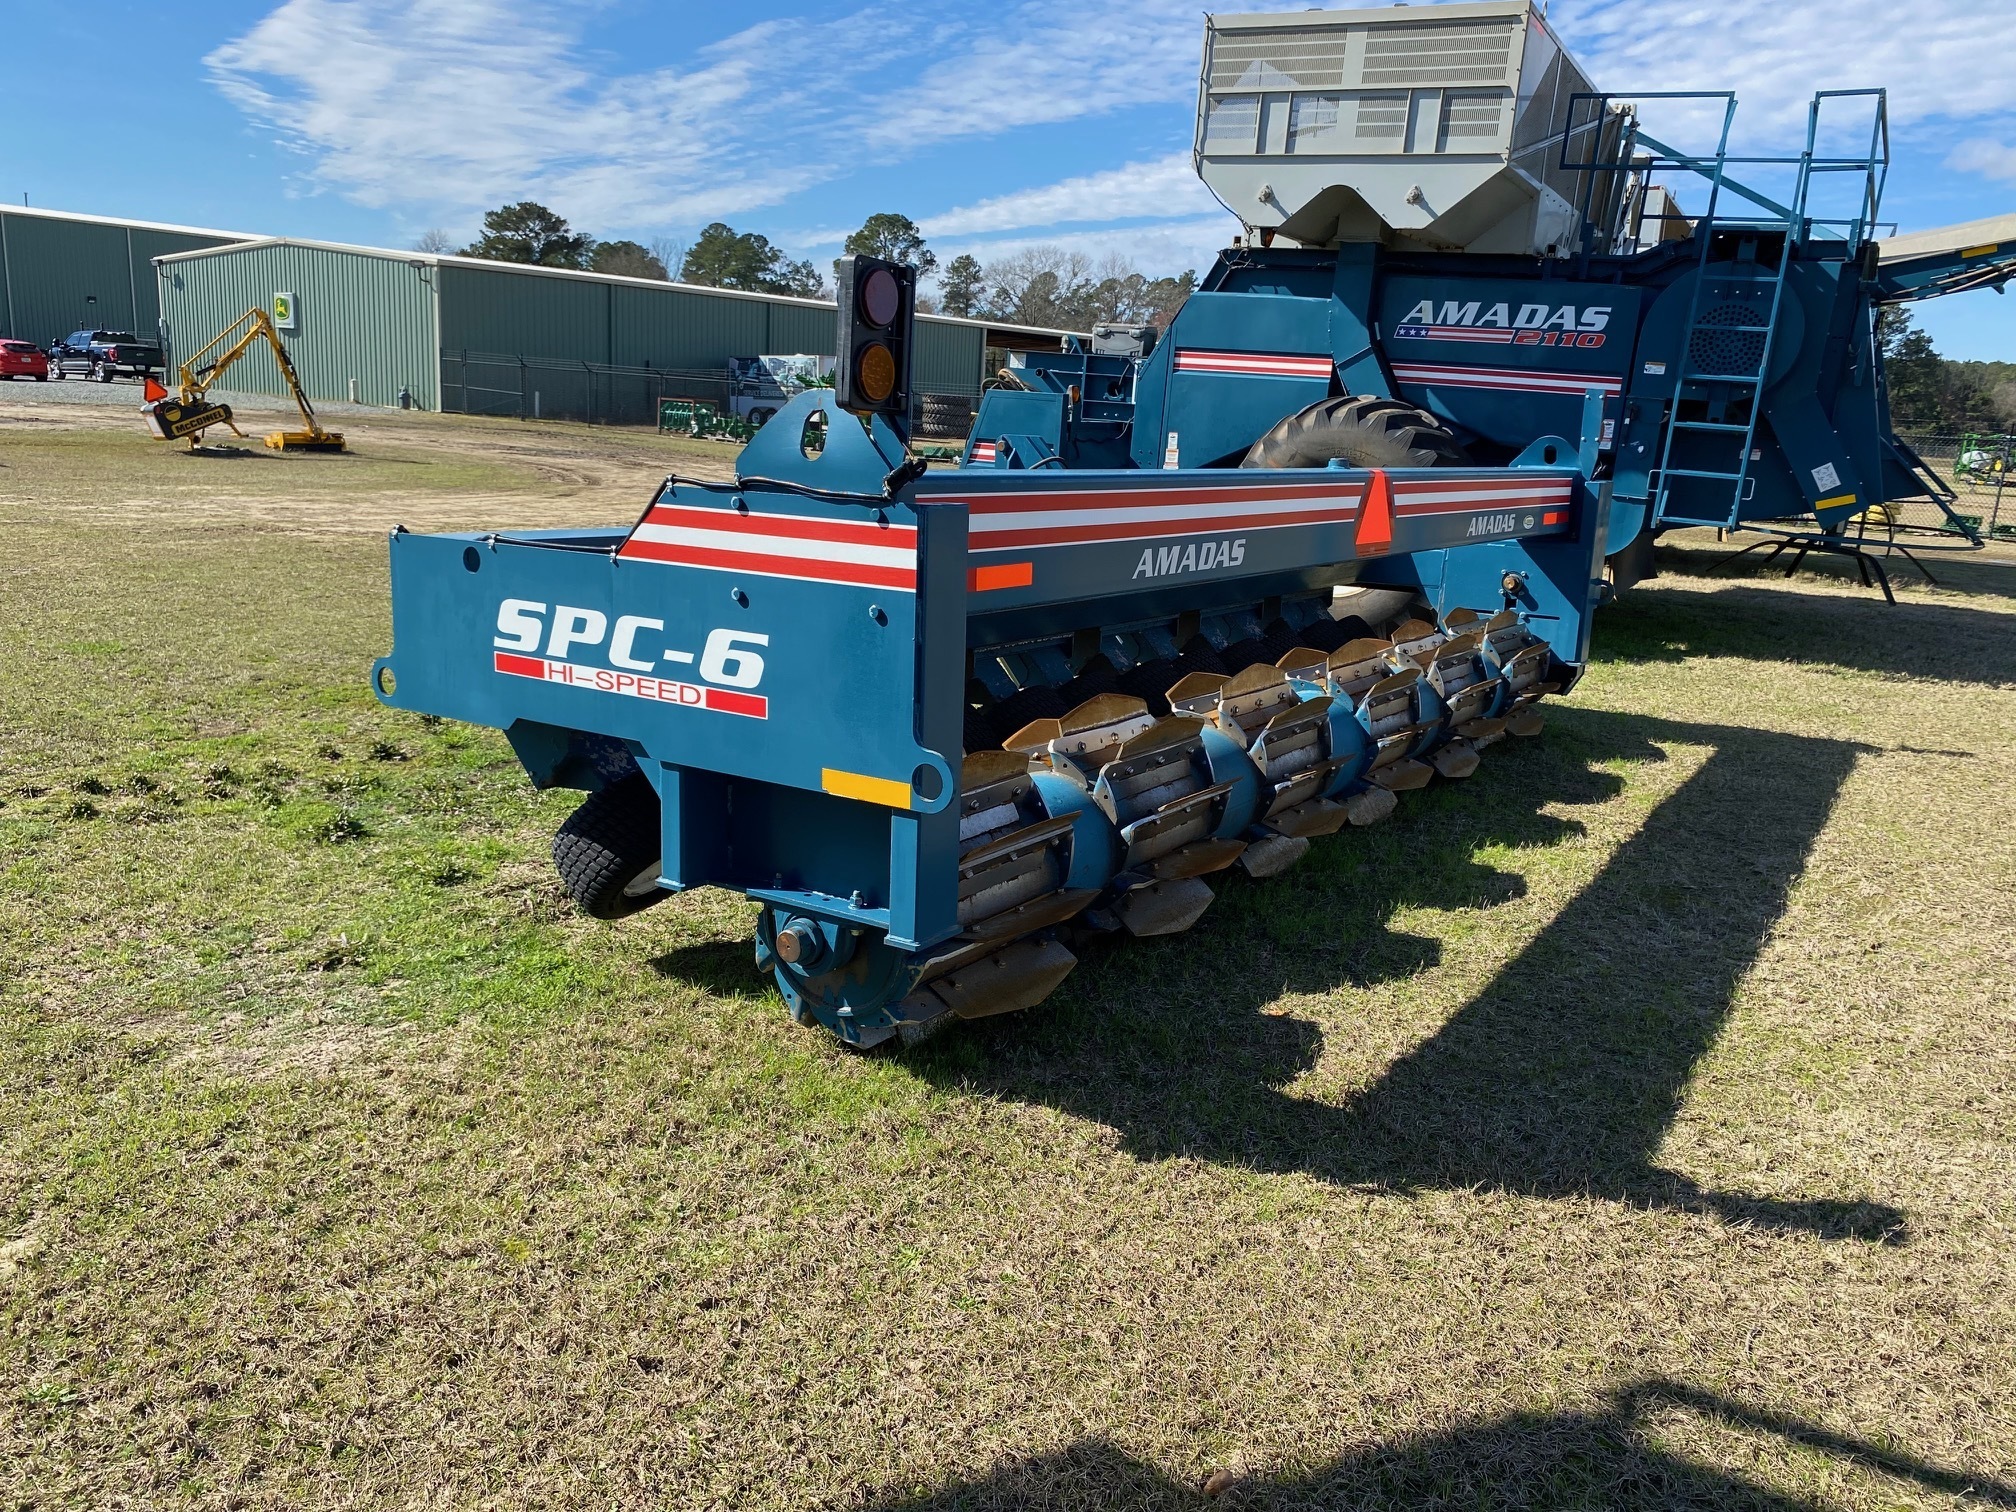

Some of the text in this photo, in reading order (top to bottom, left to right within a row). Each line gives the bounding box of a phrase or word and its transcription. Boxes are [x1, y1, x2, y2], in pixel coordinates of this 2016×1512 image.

[1401, 300, 1612, 331] AMADAS
[1513, 330, 1607, 348] 2110
[175, 410, 224, 433] McCONNEL
[1466, 514, 1516, 537] AMADAS
[1131, 539, 1246, 579] AMADAS
[493, 598, 769, 689] SPC-6
[548, 662, 702, 705] HI-SPEED
